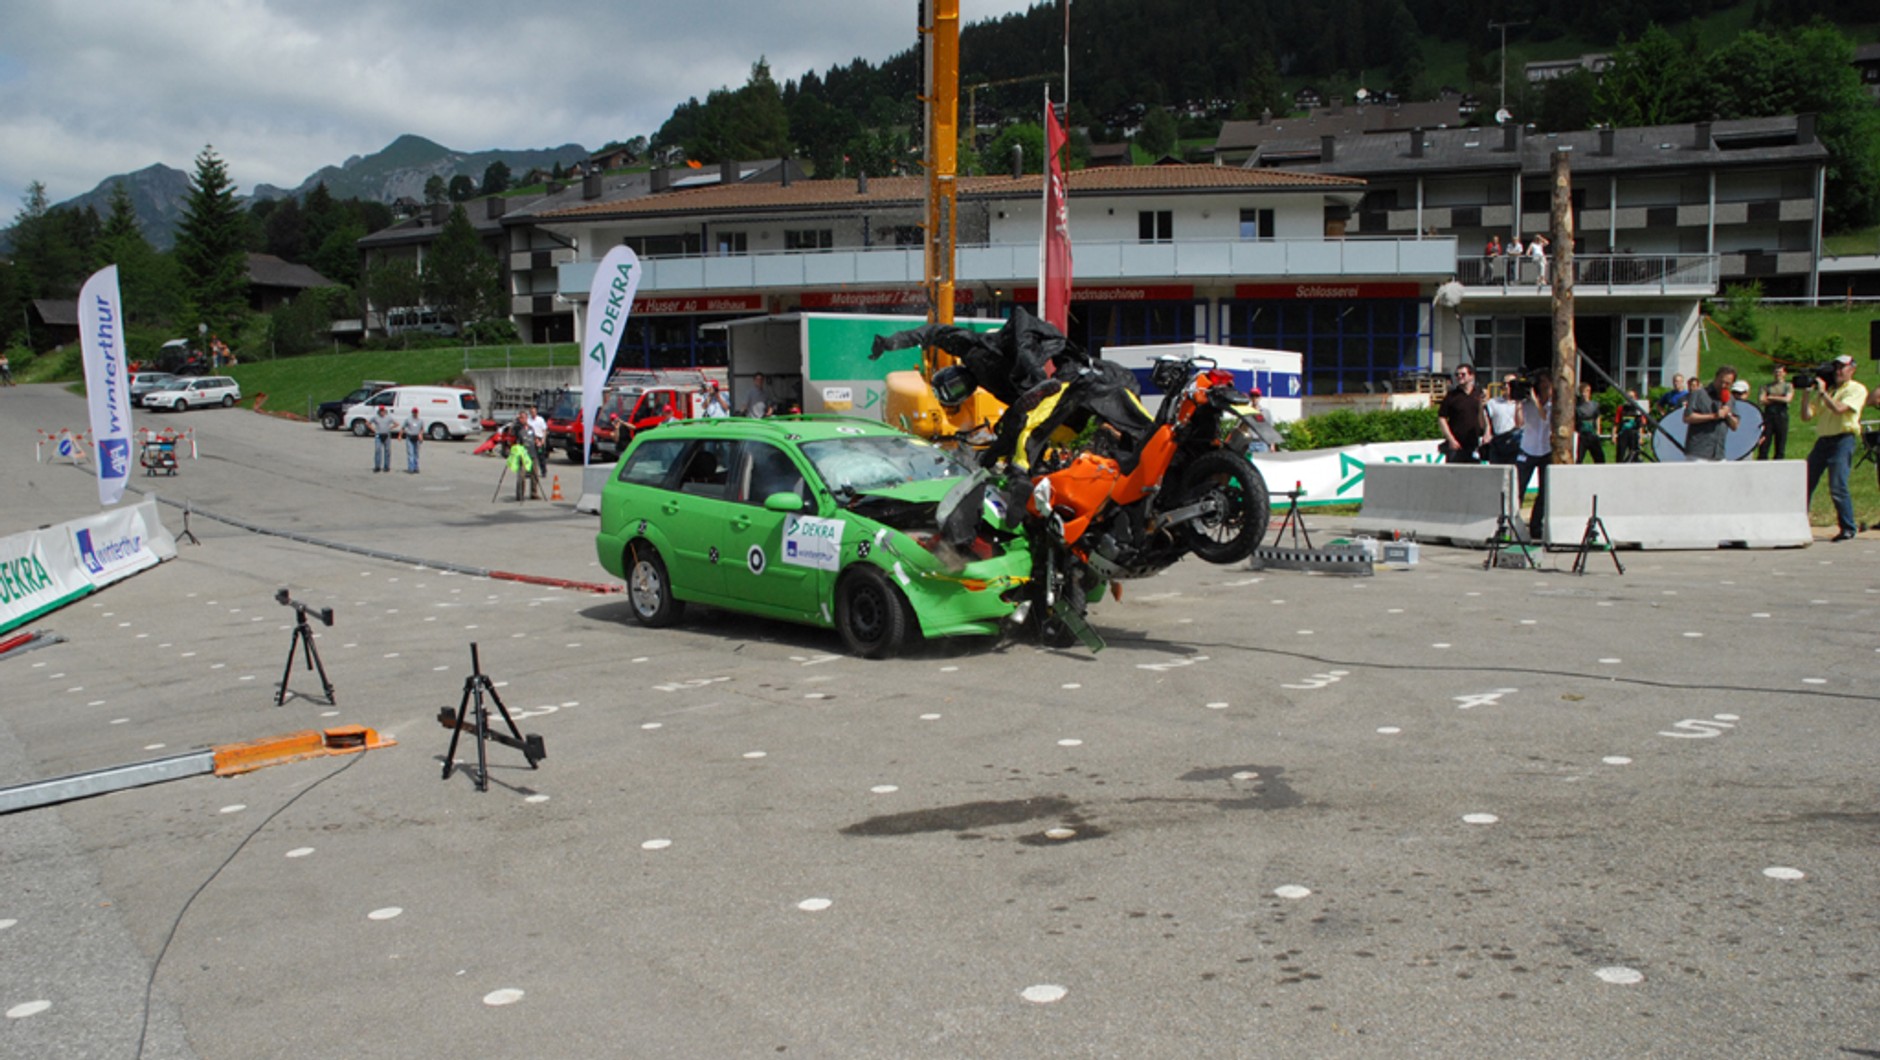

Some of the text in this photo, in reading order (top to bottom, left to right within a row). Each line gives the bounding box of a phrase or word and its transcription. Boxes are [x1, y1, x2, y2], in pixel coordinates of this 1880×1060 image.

[600, 263, 633, 336] DEKRA
[1295, 284, 1359, 298] Schlosserei
[645, 299, 680, 313] Huser
[683, 300, 698, 312] AG
[707, 299, 747, 310] Wildhaus
[96, 294, 122, 434] winterthur
[801, 521, 835, 539] DEKRA
[1657, 719, 1735, 738] 5
